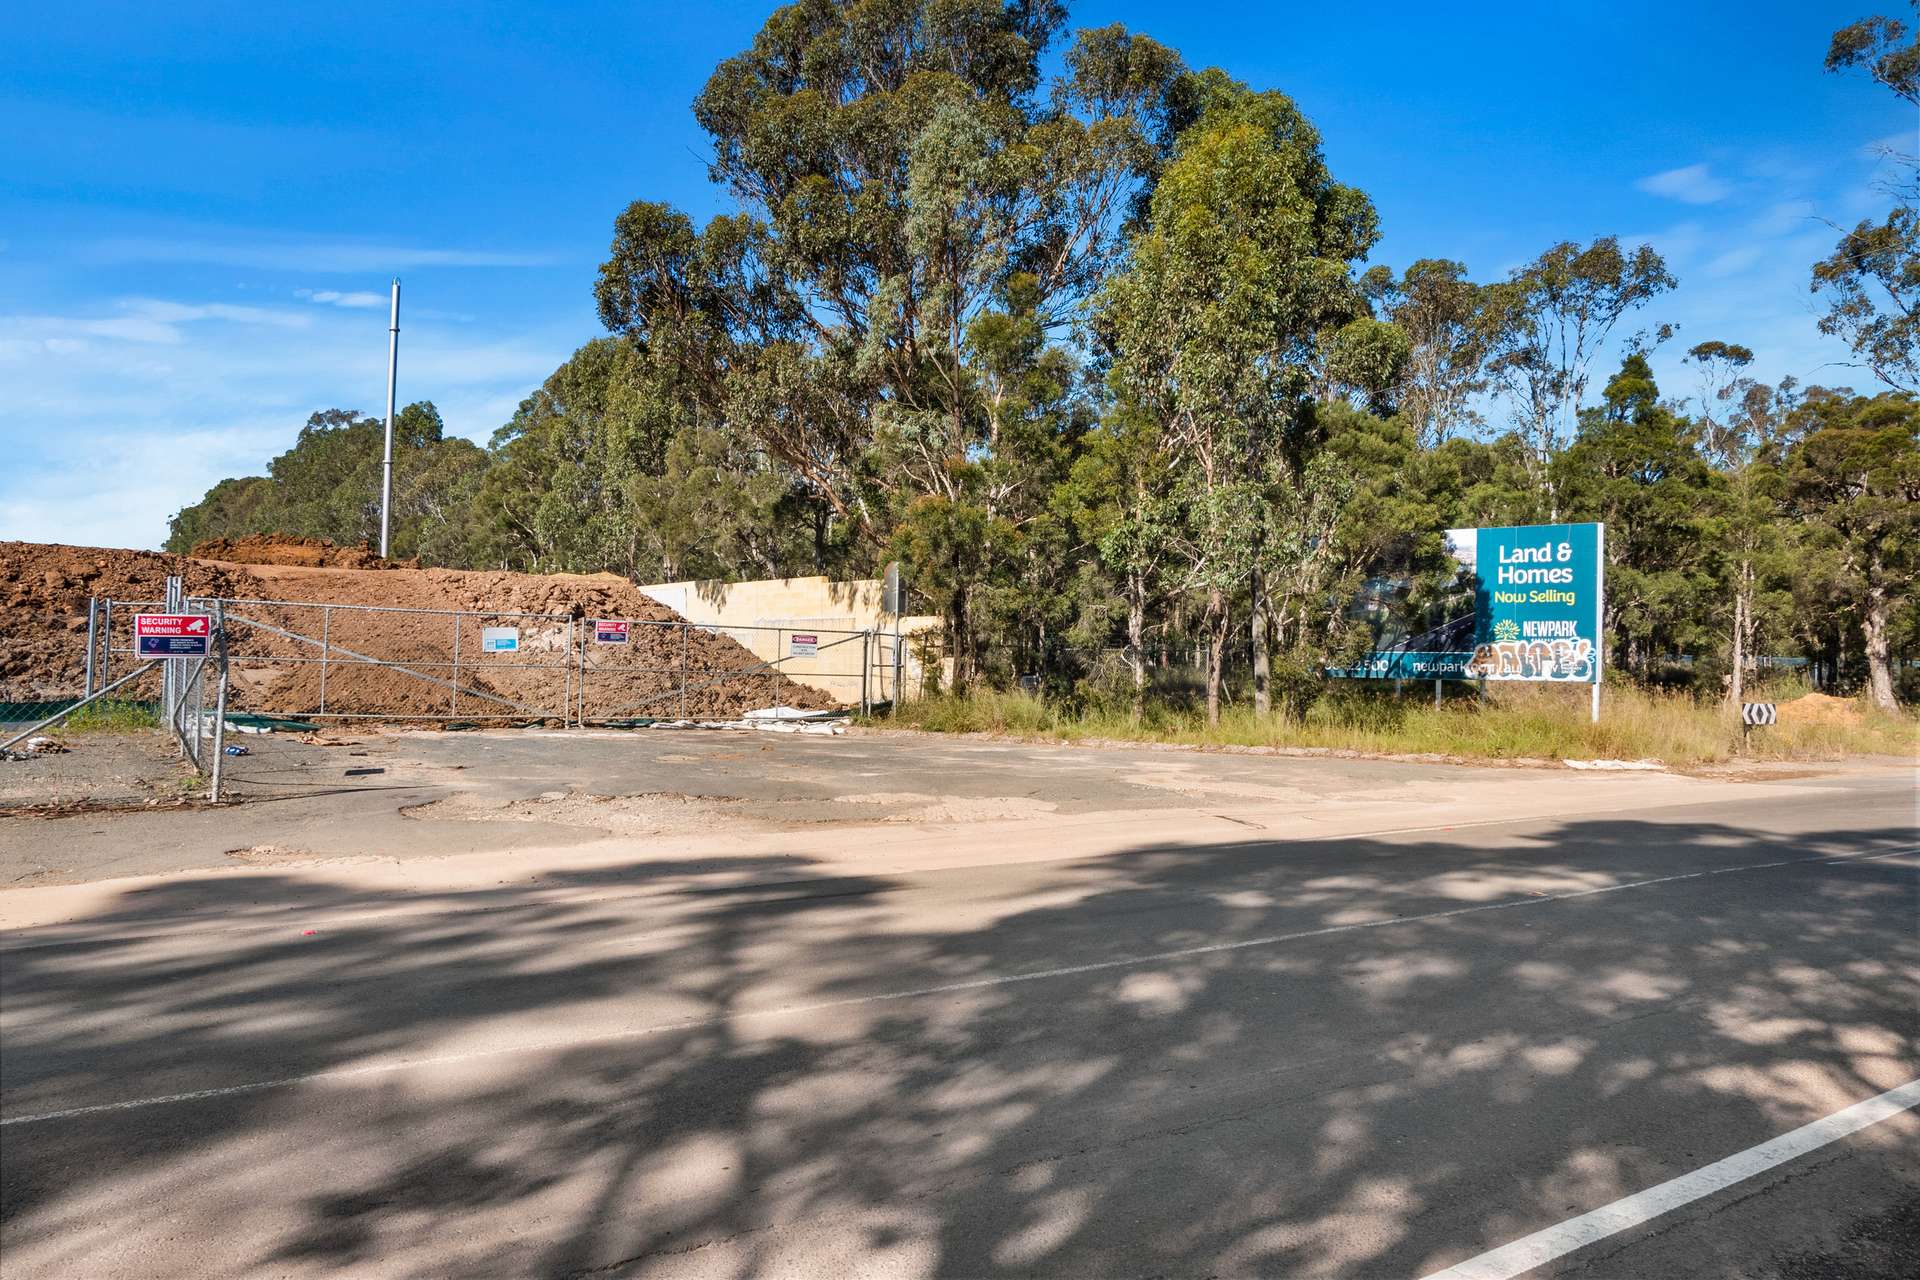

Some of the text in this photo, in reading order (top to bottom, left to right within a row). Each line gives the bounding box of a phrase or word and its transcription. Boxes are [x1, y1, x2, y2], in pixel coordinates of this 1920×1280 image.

[1499, 542, 1573, 563] Land &
[1498, 565, 1573, 585] Homes
[1494, 589, 1575, 606] Now Selling
[141, 617, 183, 625] SECURITY
[1522, 620, 1578, 637] NEWPARK
[141, 626, 182, 634] WARNING
[1363, 660, 1389, 671] 500
